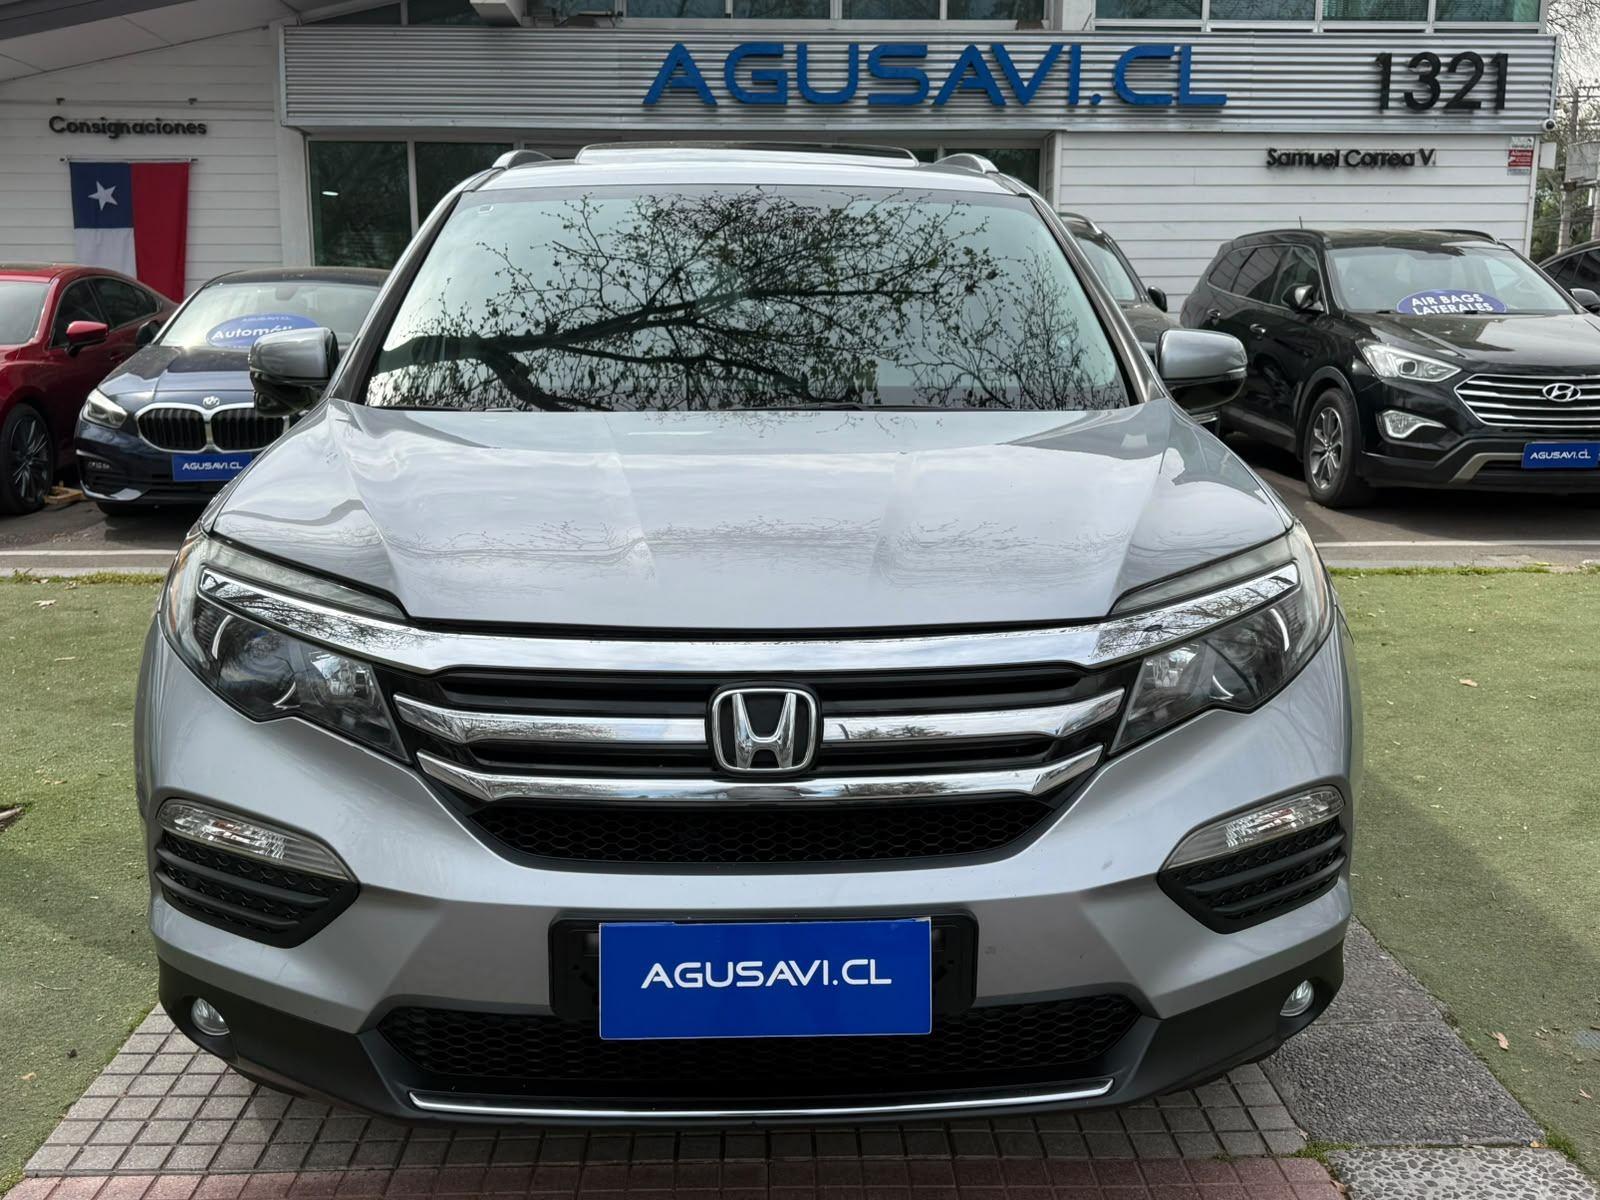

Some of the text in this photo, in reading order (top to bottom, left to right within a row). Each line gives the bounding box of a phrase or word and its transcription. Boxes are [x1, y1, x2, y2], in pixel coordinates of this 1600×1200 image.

[642, 42, 1228, 106] AGUSAVI.CL
[1376, 52, 1509, 111] 1321
[49, 116, 207, 139] Consignaciones
[1266, 148, 1341, 168] Samuel
[1344, 149, 1415, 168] Correa
[1411, 293, 1484, 307] AIR BAGS
[1412, 302, 1494, 315] LATERALES
[211, 324, 293, 339] Autom
[1530, 449, 1591, 460] AGUSAVI.CL
[182, 461, 243, 471] AGUSAVI.CL
[640, 959, 893, 989] AGUSAVI.CL
